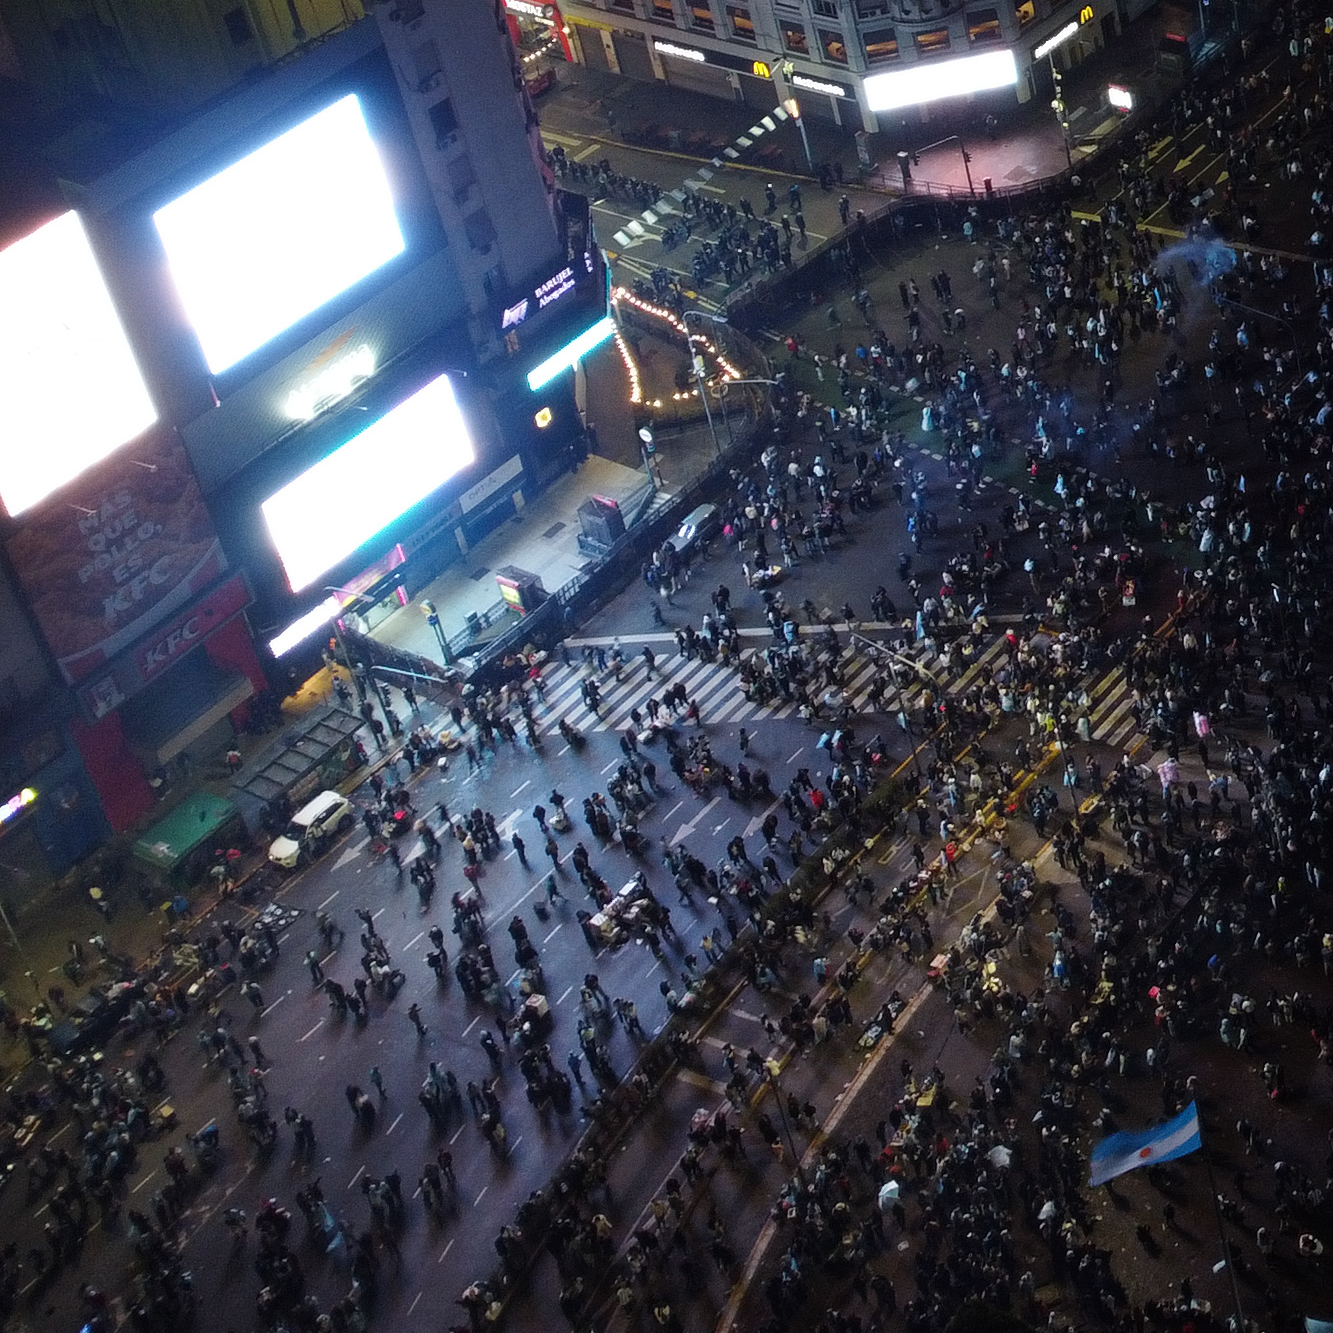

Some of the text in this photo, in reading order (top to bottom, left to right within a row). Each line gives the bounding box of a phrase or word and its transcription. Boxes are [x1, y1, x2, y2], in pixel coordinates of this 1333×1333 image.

[539, 278, 576, 309] Abogados
[78, 489, 132, 536] MÁS
[87, 511, 138, 552] QUE
[78, 521, 163, 584] POLLO,
[102, 554, 172, 619] KFC
[143, 616, 199, 673] KFC
